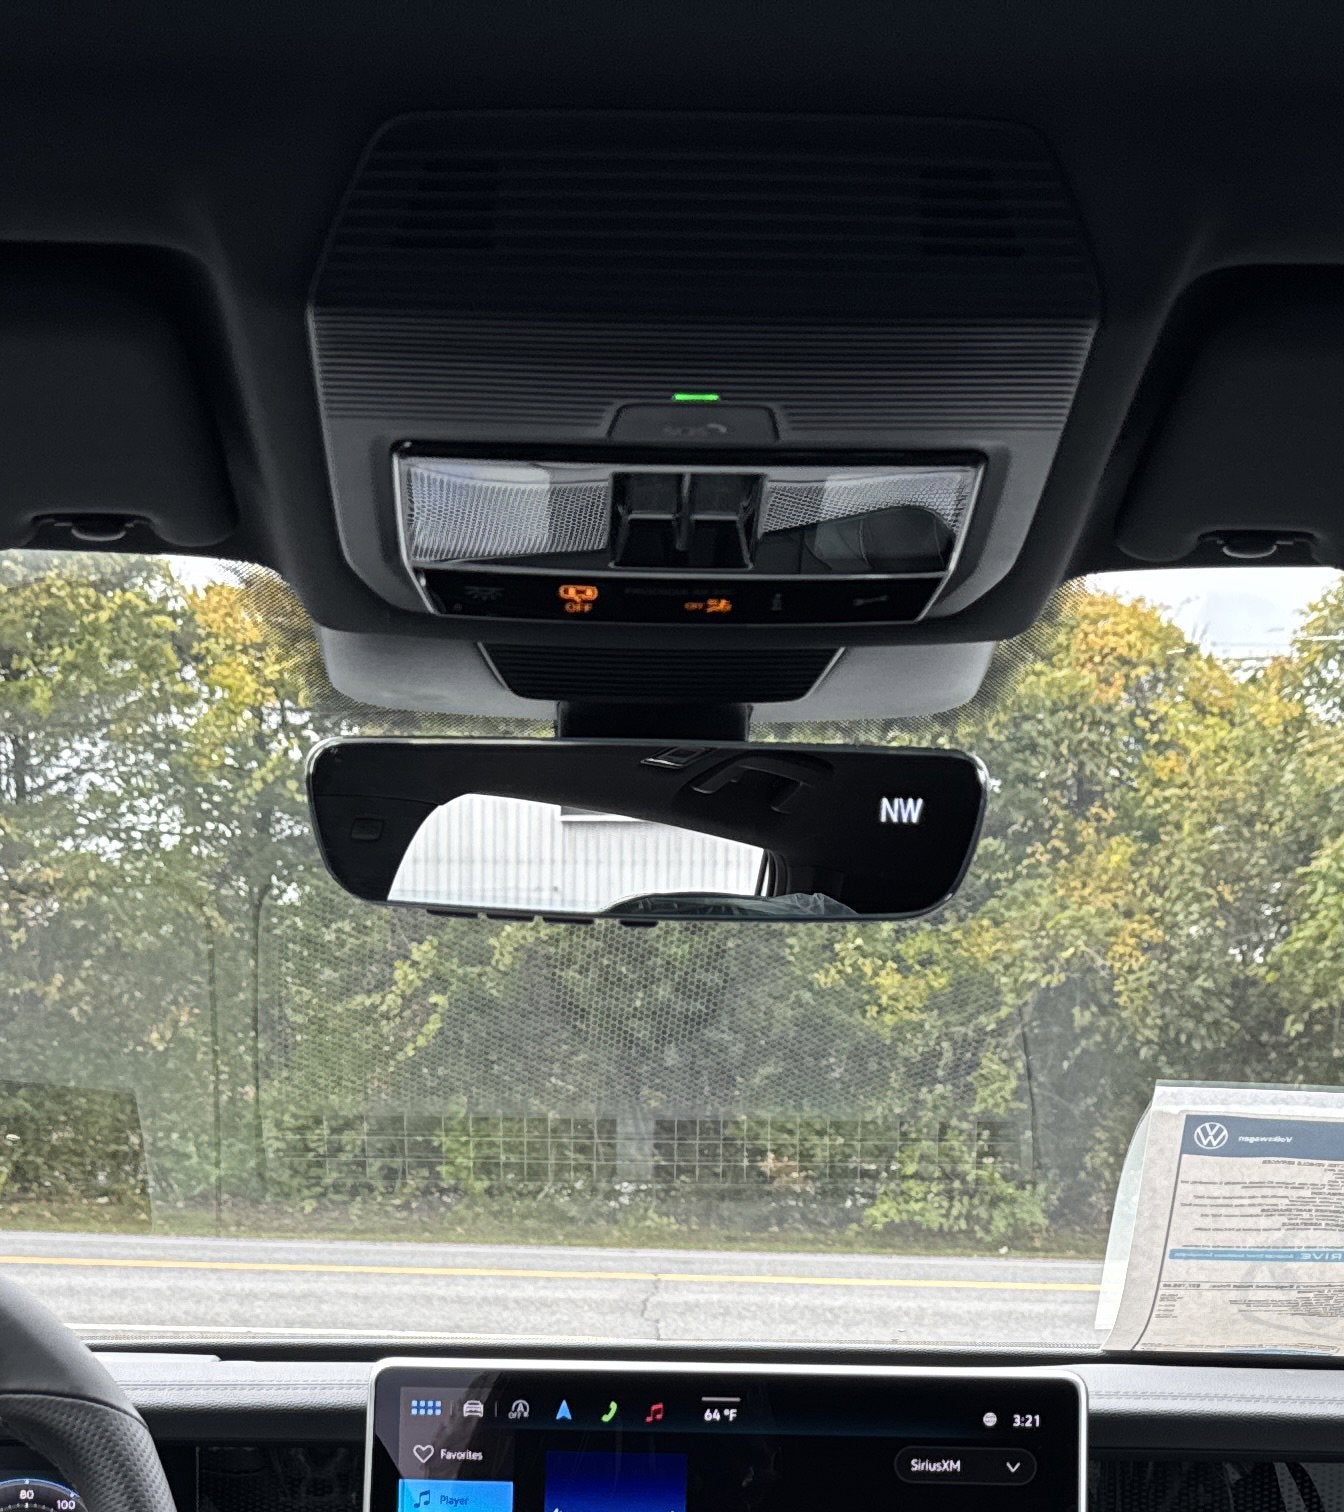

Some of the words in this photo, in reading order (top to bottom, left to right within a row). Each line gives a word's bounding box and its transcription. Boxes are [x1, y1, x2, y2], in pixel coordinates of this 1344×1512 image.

[880, 797, 923, 823] NW
[704, 1409, 721, 1422] 64
[1012, 1414, 1040, 1428] 3:21
[440, 1449, 483, 1462] Favorites
[910, 1458, 961, 1473] SiriusXM
[20, 1490, 34, 1499] 80
[439, 1495, 469, 1507] Player
[57, 1500, 76, 1510] 100
